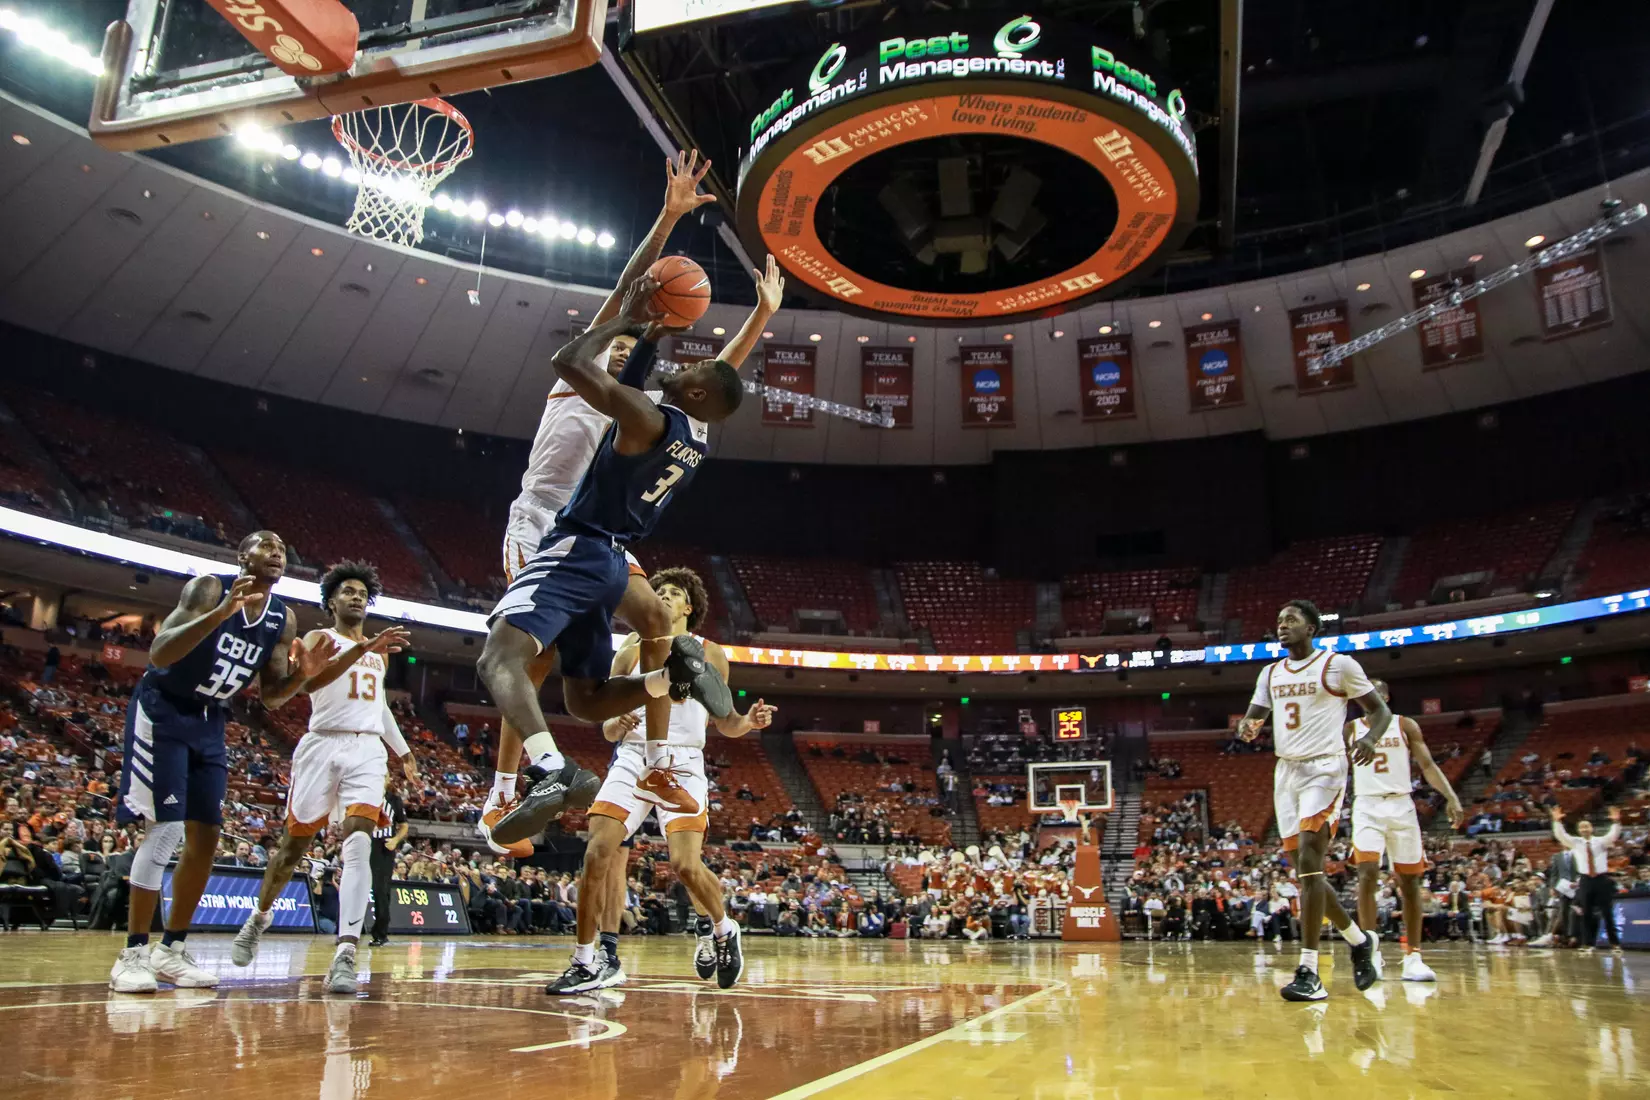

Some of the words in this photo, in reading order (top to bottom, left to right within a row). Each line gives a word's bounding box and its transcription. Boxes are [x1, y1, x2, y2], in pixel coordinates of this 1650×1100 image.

[879, 32, 969, 65] Pest
[879, 57, 1054, 85] Management
[1091, 45, 1157, 98] Pest
[750, 88, 794, 143] Pest
[952, 109, 986, 125] love
[959, 94, 1013, 113] Where
[1016, 101, 1087, 124] students
[749, 78, 857, 163] Management
[848, 104, 921, 140] AMERICAN
[854, 112, 929, 148] CAMPUS
[1115, 160, 1154, 203] CAMPUS
[1127, 157, 1168, 199] AMERICAN
[1302, 308, 1337, 322] TEXAS
[1196, 329, 1230, 342] TEXAS
[682, 341, 713, 352] TEXAS
[775, 351, 806, 360] TEXAS
[971, 351, 1002, 360] TEXAS
[1090, 342, 1121, 353] TEXAS
[872, 352, 904, 362] TEXAS
[1202, 360, 1228, 371] NCAA
[975, 380, 1001, 389] NCAA
[1095, 372, 1120, 382] NCAA
[976, 403, 999, 414] 1943
[1096, 395, 1120, 406] 2003
[641, 464, 684, 507] 3
[264, 620, 280, 630] WAC
[105, 647, 121, 660] 33
[216, 631, 264, 665] CBU
[355, 654, 382, 672] XAS
[195, 657, 254, 700] 35
[347, 671, 377, 702] 13
[1271, 681, 1317, 700] TEXAS
[1284, 701, 1301, 731] 3
[1059, 721, 1081, 739] 25
[1374, 752, 1390, 774] 2
[396, 887, 429, 906] 16:58
[438, 892, 454, 907] CBU
[410, 910, 425, 925] 25
[445, 909, 459, 924] 22
